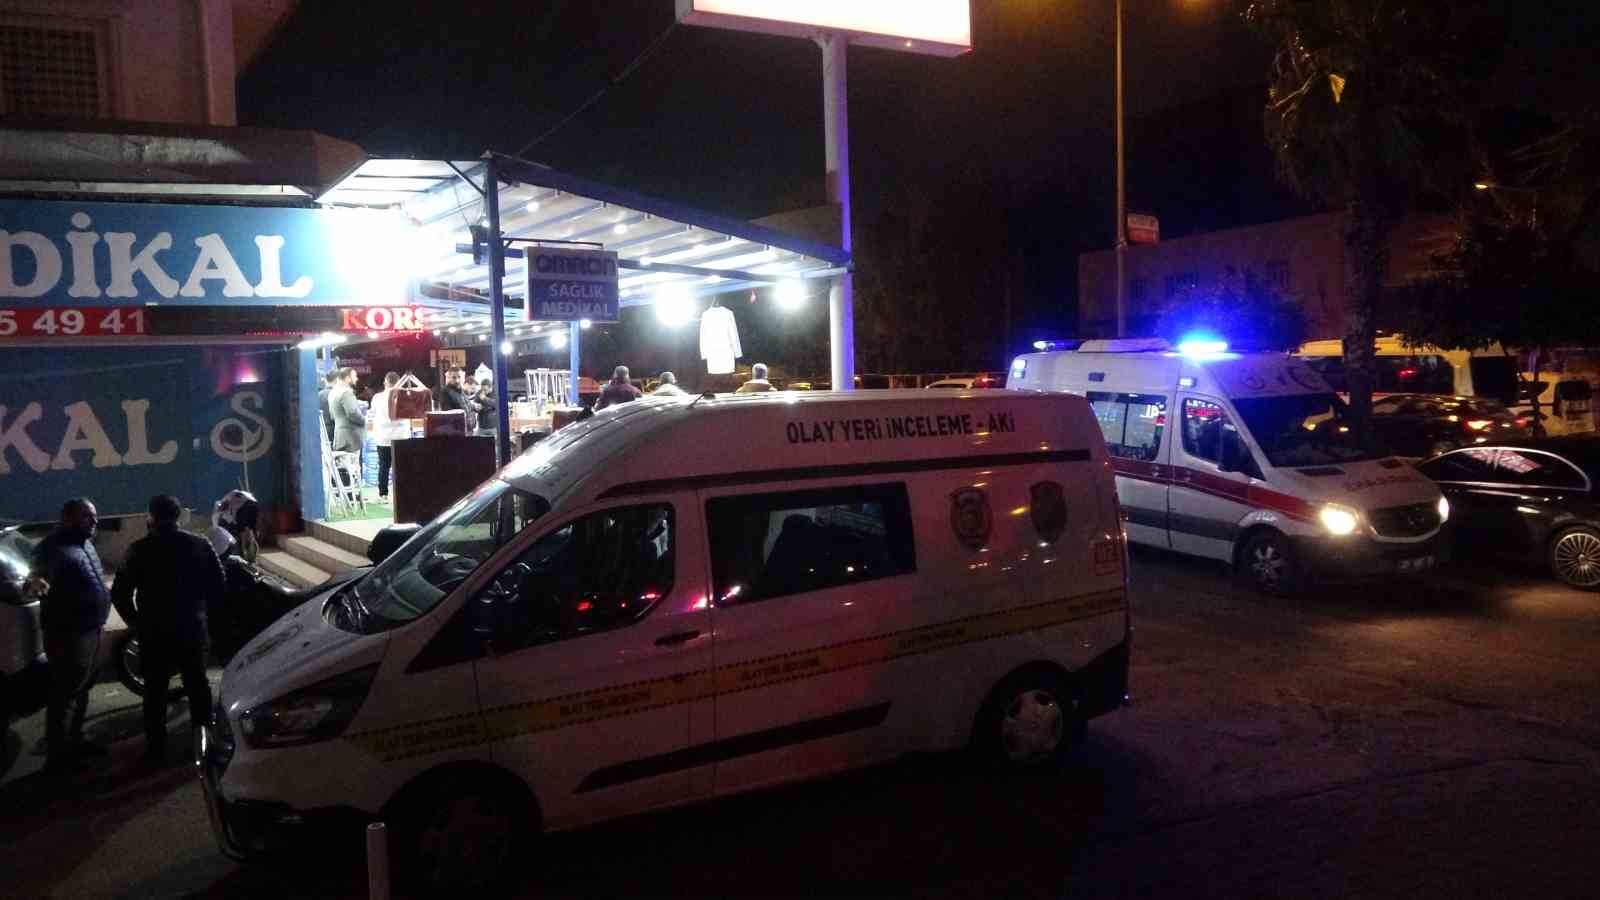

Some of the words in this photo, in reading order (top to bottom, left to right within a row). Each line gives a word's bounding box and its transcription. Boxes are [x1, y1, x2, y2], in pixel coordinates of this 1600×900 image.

[549, 280, 604, 298] SAĞLIK
[542, 299, 612, 317] MEDİKAL
[32, 309, 85, 335] 49
[99, 308, 145, 334] 41
[786, 420, 835, 444] OLAY
